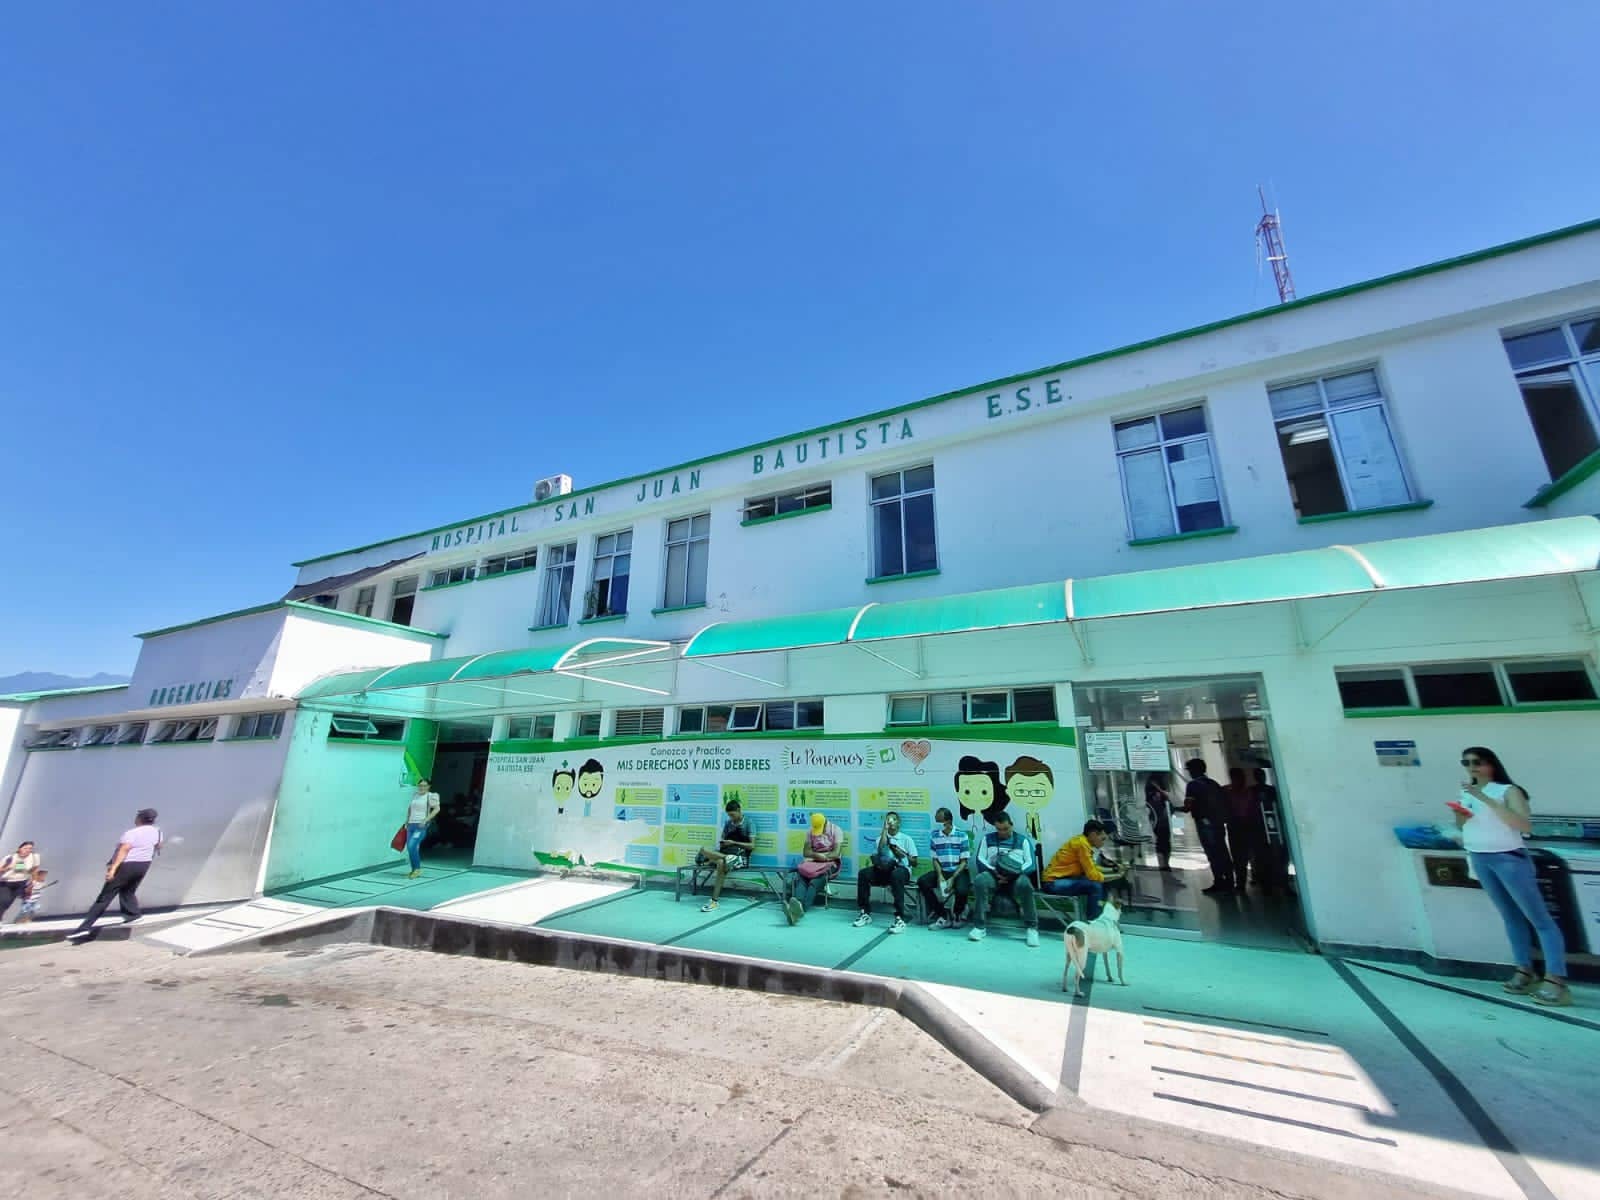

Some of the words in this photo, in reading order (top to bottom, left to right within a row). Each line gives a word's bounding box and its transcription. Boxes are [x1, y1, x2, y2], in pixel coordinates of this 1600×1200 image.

[432, 516, 519, 551] HOSPITAL
[554, 496, 595, 522] SAN
[636, 470, 701, 502] JUAN
[752, 417, 914, 475] BAUTISTA
[986, 378, 1074, 419] E.S.E.
[149, 679, 233, 706] URGENCIAS
[650, 747, 687, 756] Conozco
[695, 746, 732, 756] Practico
[805, 748, 864, 767] Ponemos
[616, 759, 634, 771] MIS
[636, 759, 689, 771] DERECHOS
[692, 759, 699, 771] Y
[701, 759, 721, 771] MIS
[724, 759, 771, 771] DEBERES
